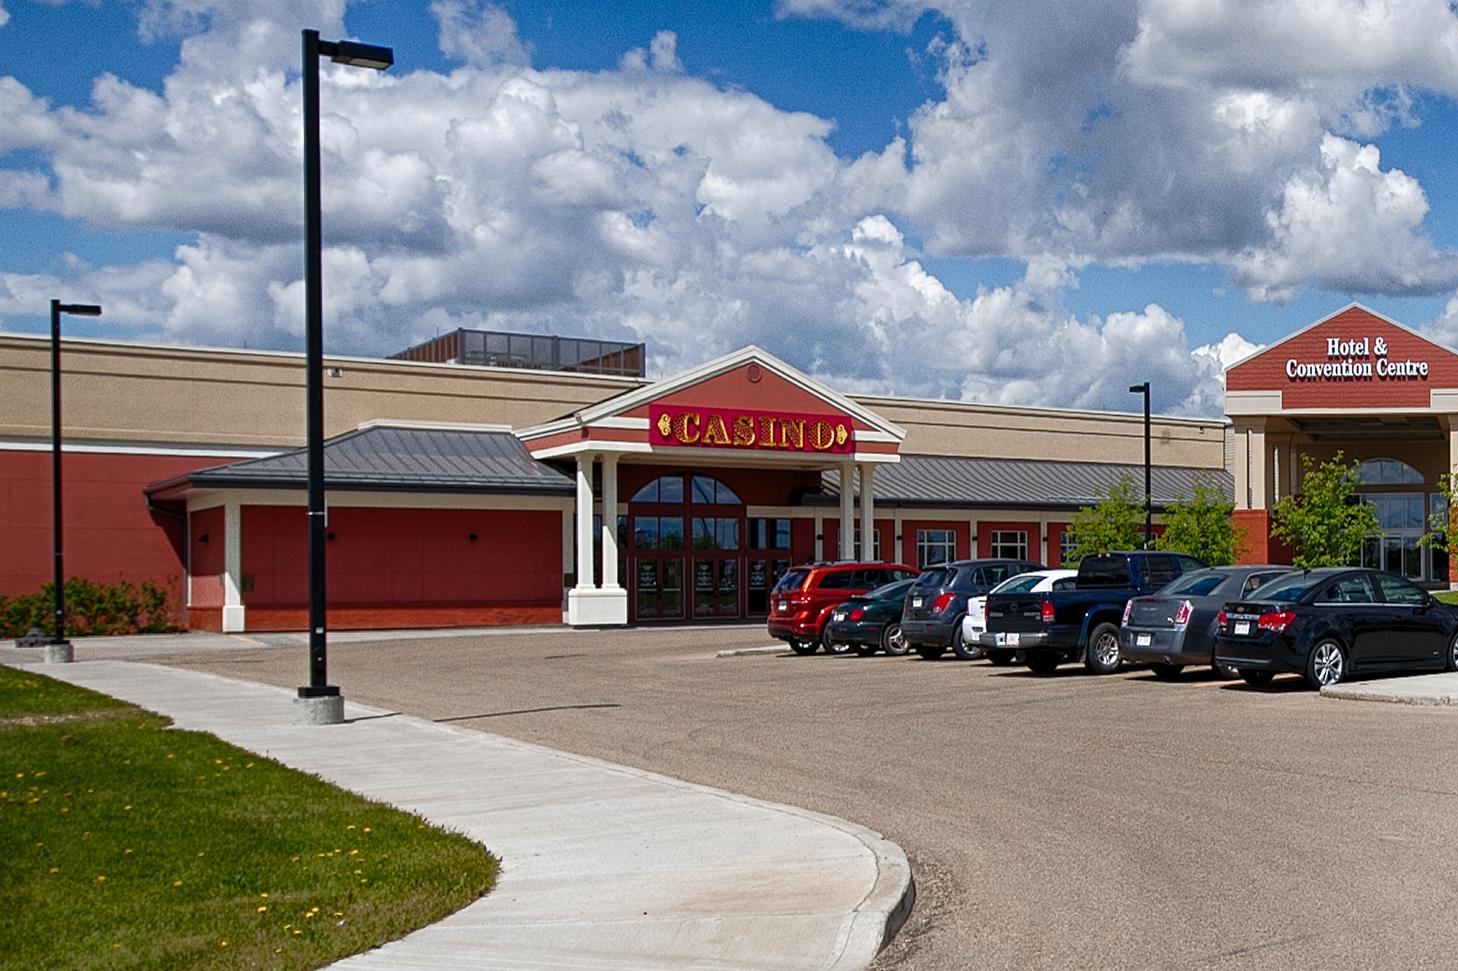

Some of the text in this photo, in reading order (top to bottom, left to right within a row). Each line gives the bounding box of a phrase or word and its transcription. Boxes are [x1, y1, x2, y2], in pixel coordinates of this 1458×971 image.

[1326, 336, 1388, 356] Hotel &
[1286, 358, 1429, 378] Convention Centre
[672, 411, 836, 450] CASINO
